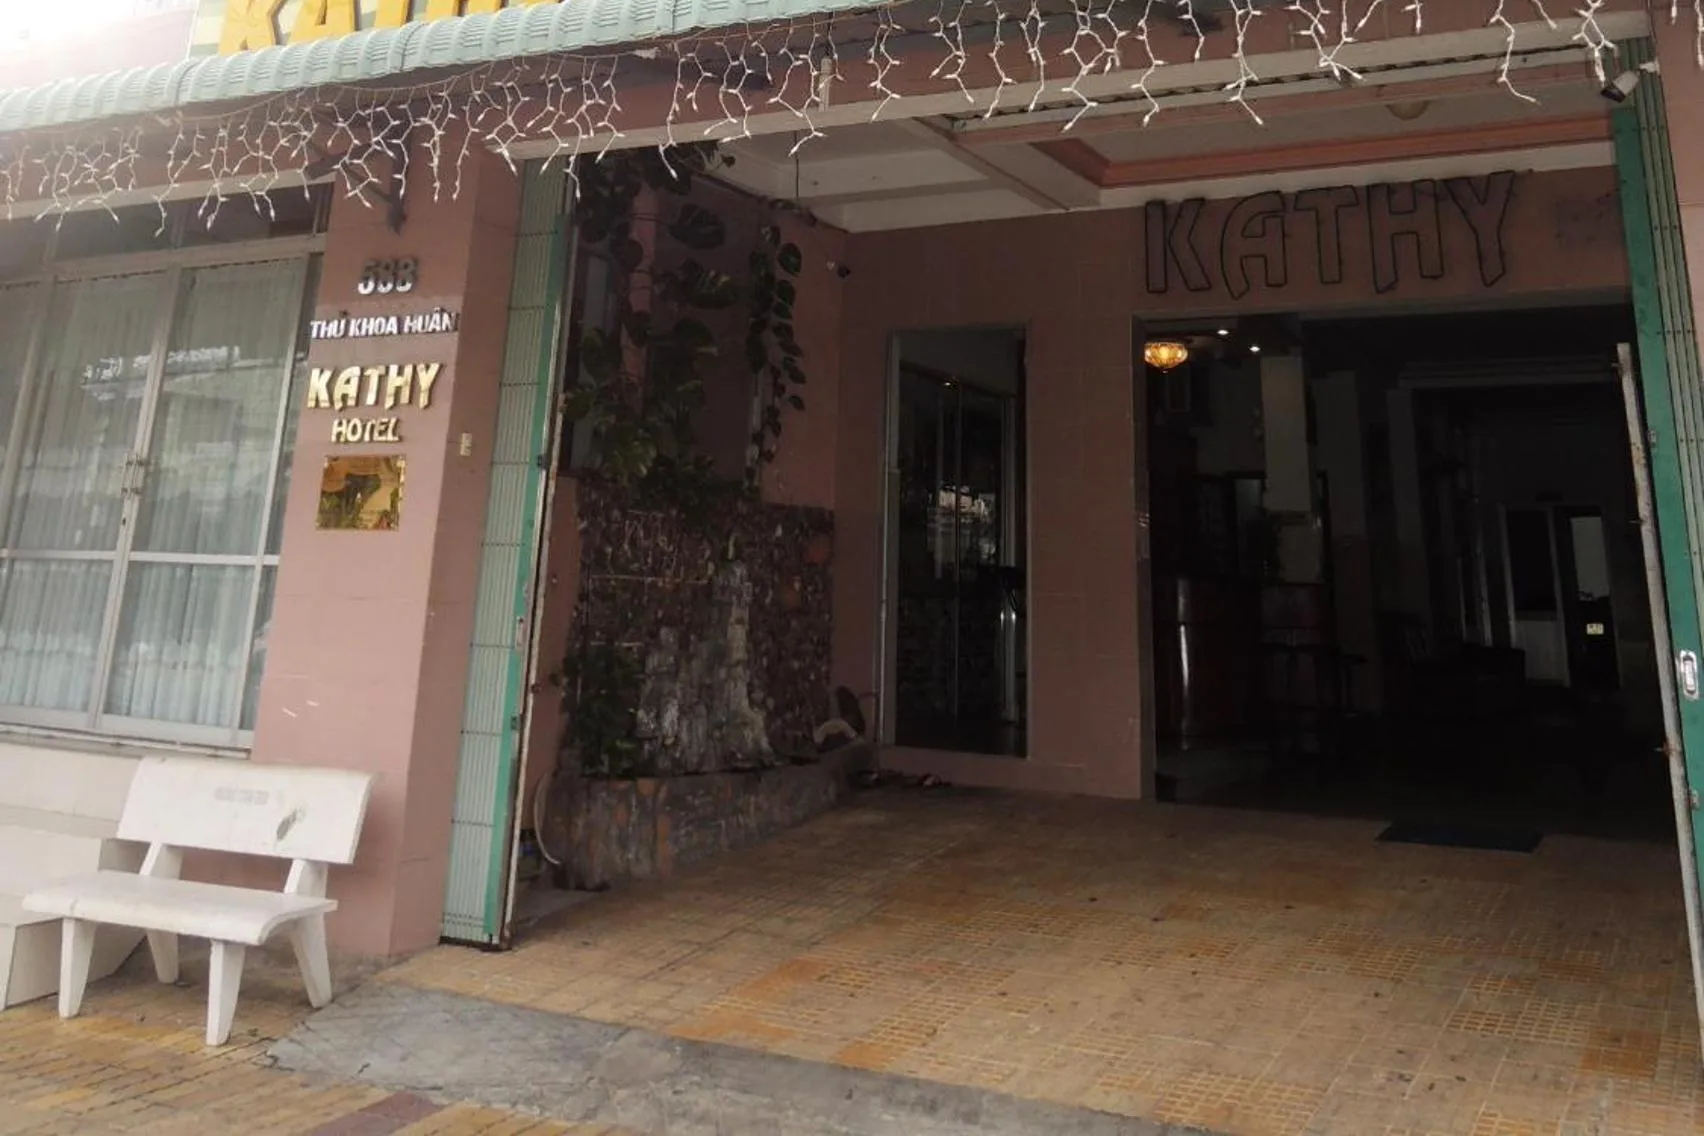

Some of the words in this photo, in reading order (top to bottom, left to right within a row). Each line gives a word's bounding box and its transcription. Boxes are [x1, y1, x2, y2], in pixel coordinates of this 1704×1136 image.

[1143, 169, 1518, 301] KATHY
[348, 316, 399, 338] KHOA
[306, 363, 444, 411] KATHY
[331, 417, 402, 443] HOTEL
